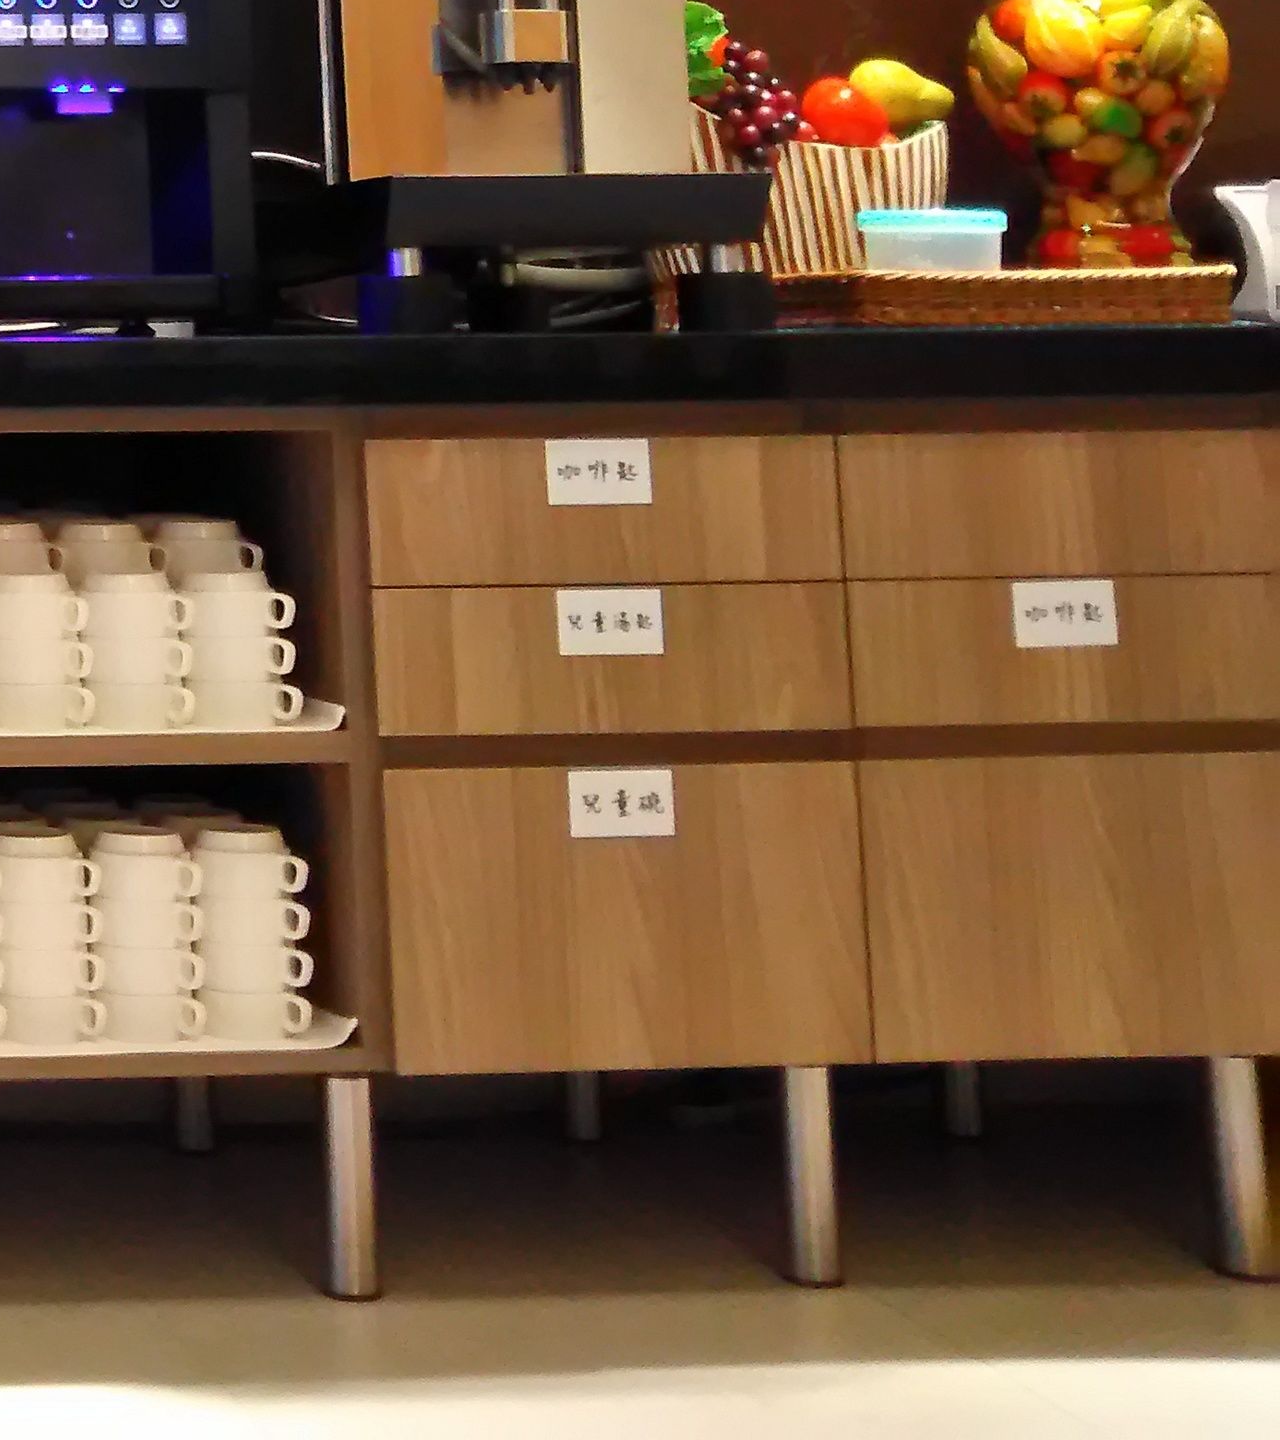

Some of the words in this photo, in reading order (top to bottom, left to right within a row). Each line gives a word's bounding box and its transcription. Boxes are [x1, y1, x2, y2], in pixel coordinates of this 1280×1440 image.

[557, 460, 638, 481] 咖啡匙
[1025, 602, 1103, 623] 咖啡匙
